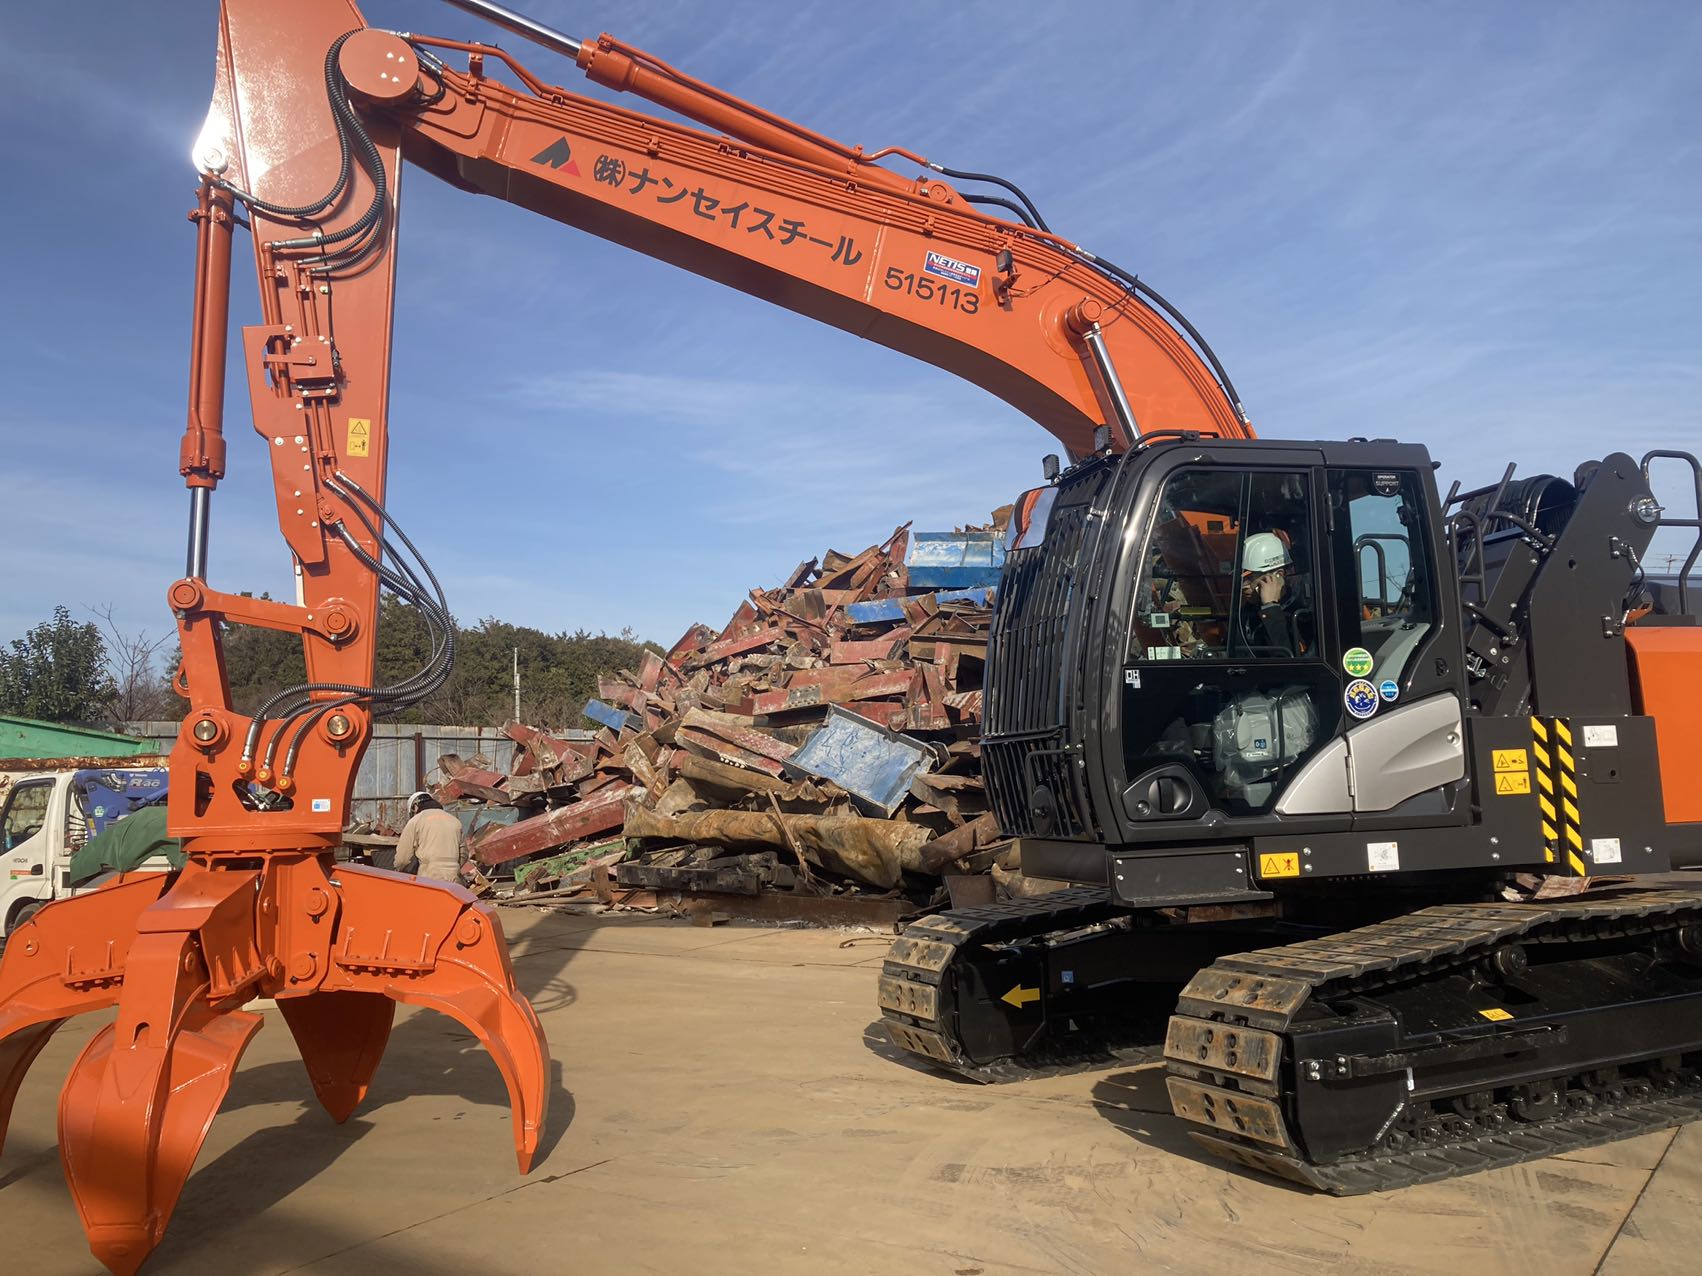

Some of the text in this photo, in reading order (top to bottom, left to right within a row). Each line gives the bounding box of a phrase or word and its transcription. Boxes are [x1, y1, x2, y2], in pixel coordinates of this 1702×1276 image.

[594, 154, 862, 266] (株)ナンセイスチール
[929, 254, 966, 272] NETIS
[884, 266, 980, 315] 515113
